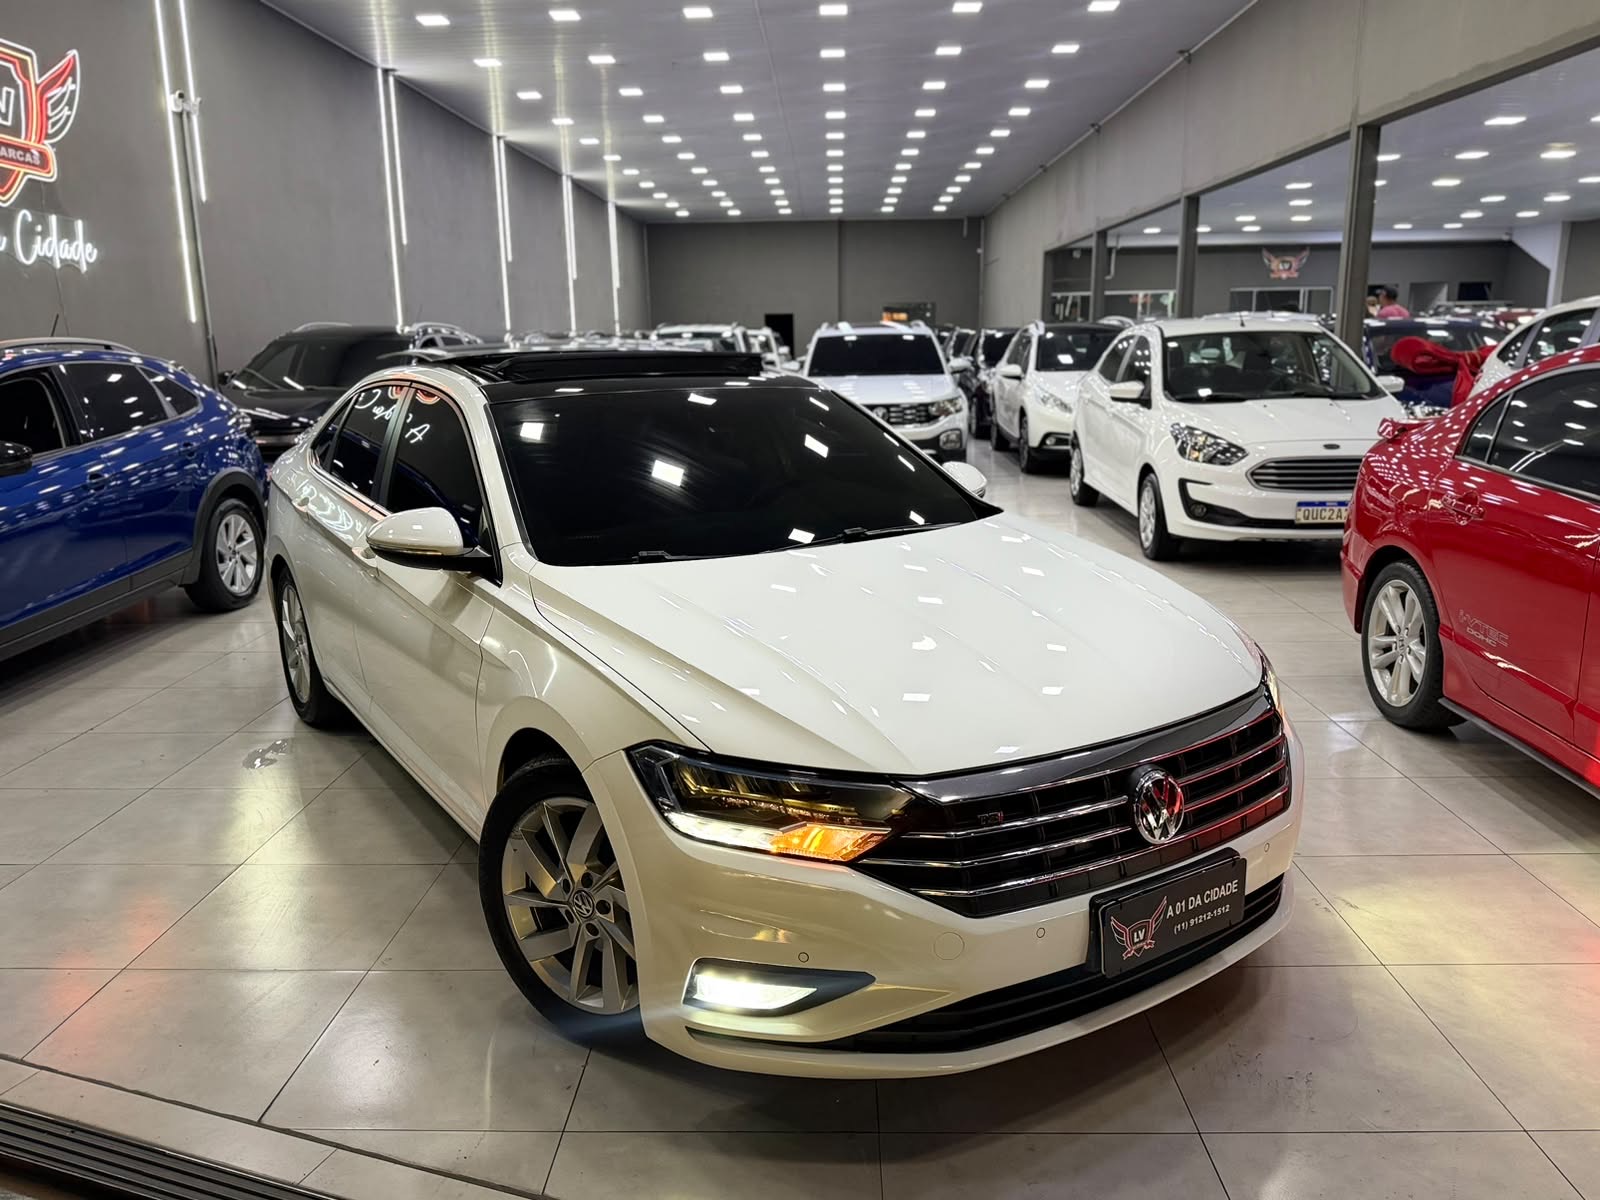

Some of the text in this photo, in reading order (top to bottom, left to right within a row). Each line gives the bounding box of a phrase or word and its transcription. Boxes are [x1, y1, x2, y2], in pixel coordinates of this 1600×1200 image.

[16, 209, 98, 274] Cidade
[1466, 627, 1497, 648] DOHC
[1166, 880, 1239, 919] A 01 DA CIDADE
[1174, 904, 1230, 935] (11) 91212-1512
[1133, 928, 1145, 943] LV
